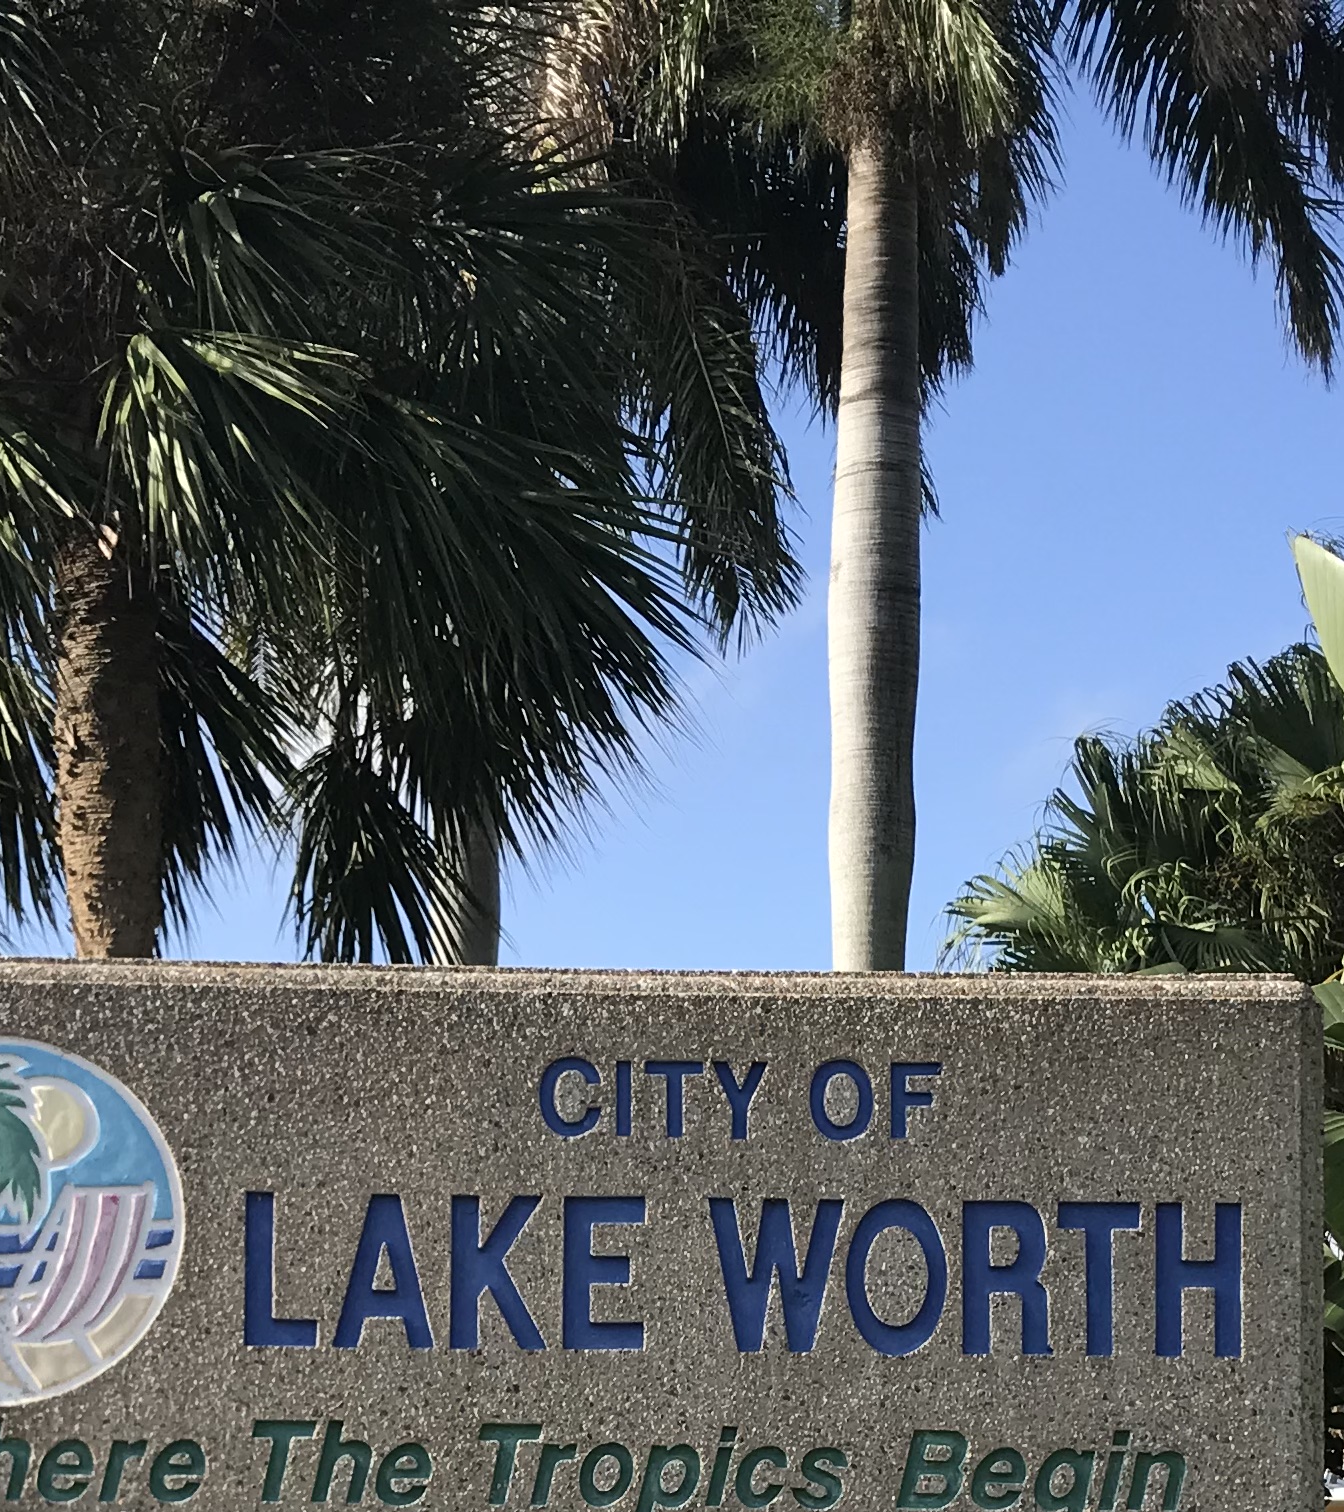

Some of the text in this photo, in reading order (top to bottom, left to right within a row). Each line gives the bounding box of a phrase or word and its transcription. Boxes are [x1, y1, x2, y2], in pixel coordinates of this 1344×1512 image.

[540, 1056, 941, 1141] CITY OF
[244, 1191, 1243, 1357] LAKE WORTH
[252, 1420, 431, 1506] The
